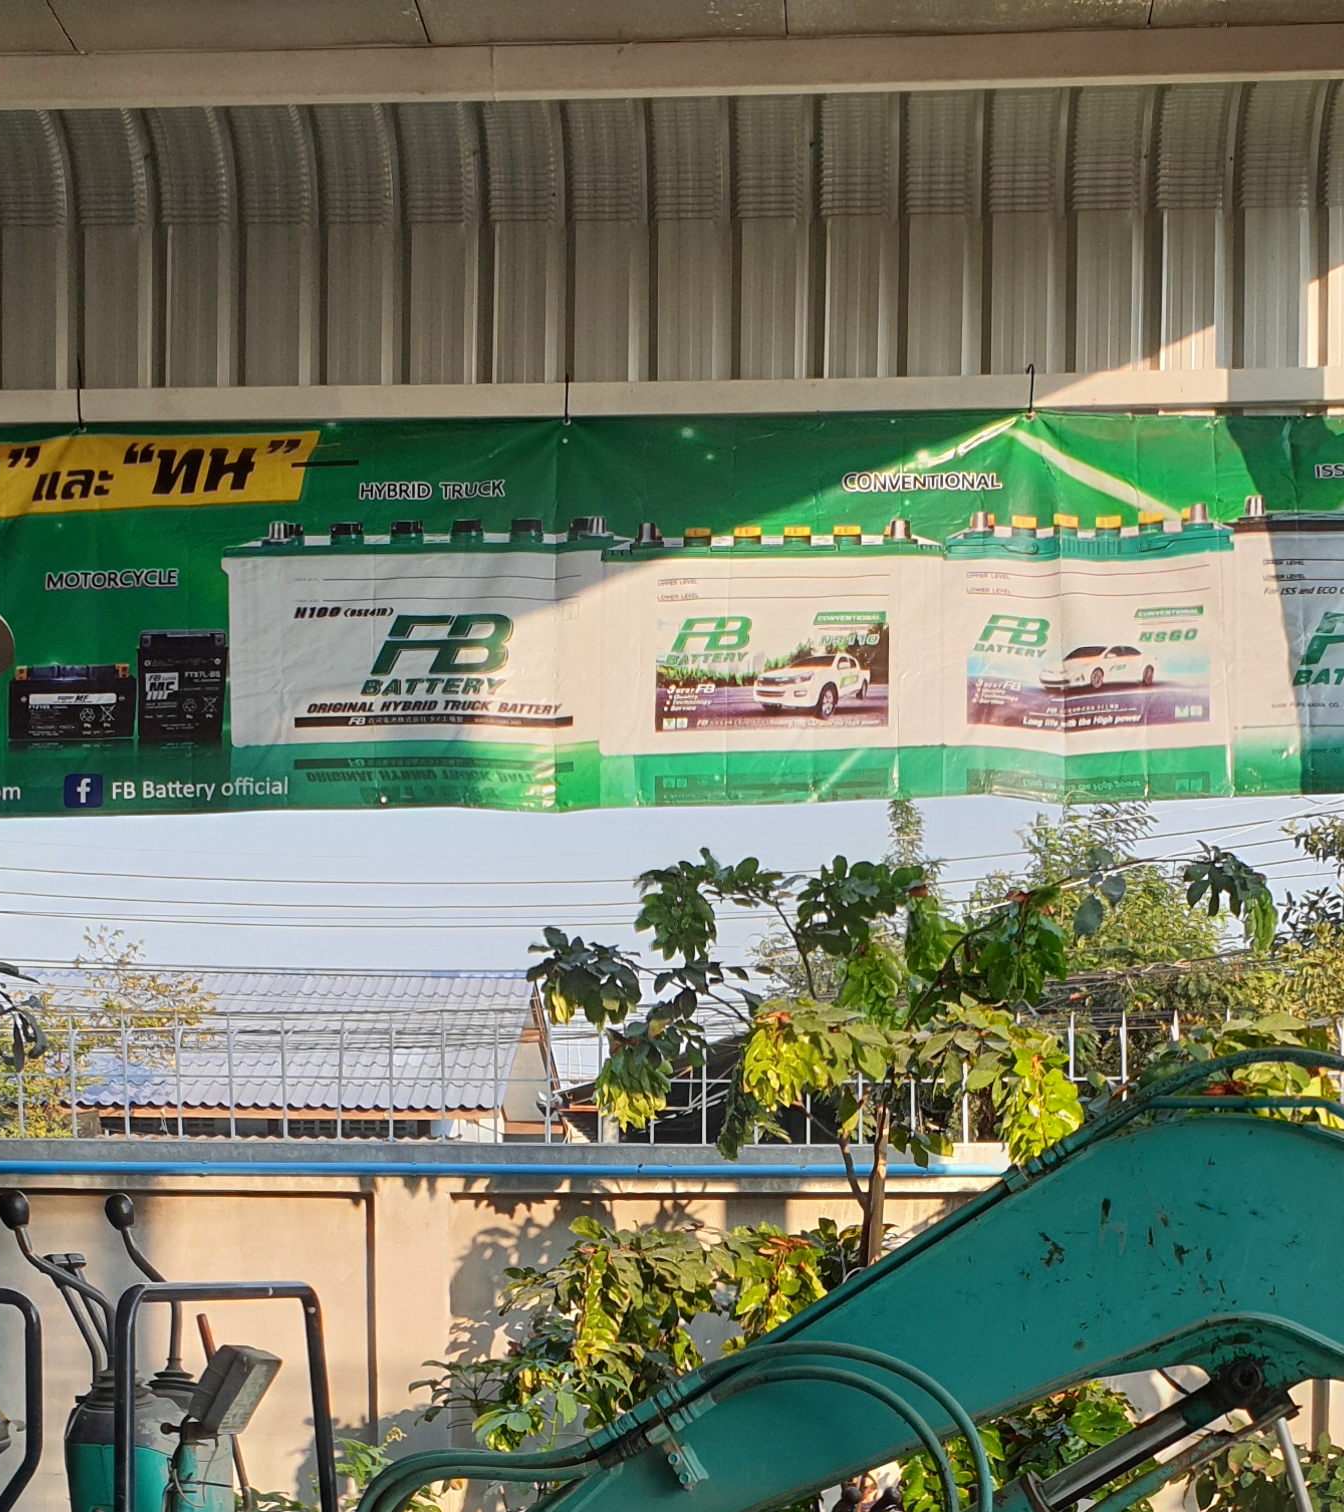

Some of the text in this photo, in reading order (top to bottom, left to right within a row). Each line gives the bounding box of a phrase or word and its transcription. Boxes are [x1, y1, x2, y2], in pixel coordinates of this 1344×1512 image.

[32, 468, 115, 503] และ
[358, 479, 506, 501] HYBRID TRUCK
[842, 471, 1002, 492] CONVENTIONAL
[45, 568, 179, 591] MOTORCYCLE
[1280, 586, 1296, 595] ISS
[1316, 586, 1337, 595] ECO
[293, 606, 341, 619] N100
[670, 616, 753, 652] FB
[978, 614, 1050, 648] FB
[370, 613, 514, 677] FB
[973, 643, 1047, 659] BATTERY
[665, 651, 749, 666] BATTERY
[361, 677, 508, 697] BATTERY
[695, 684, 716, 694] FB
[307, 700, 562, 716] ORIGINAL HYBRID TRUCK BATTERY
[348, 716, 367, 726] FB
[1023, 716, 1043, 727] Long
[1044, 716, 1059, 728] life
[1078, 716, 1091, 727] the
[1093, 714, 1113, 726] High
[1114, 713, 1142, 725] power
[112, 781, 136, 799] FB
[143, 780, 216, 801] Battery
[221, 776, 289, 796] official
